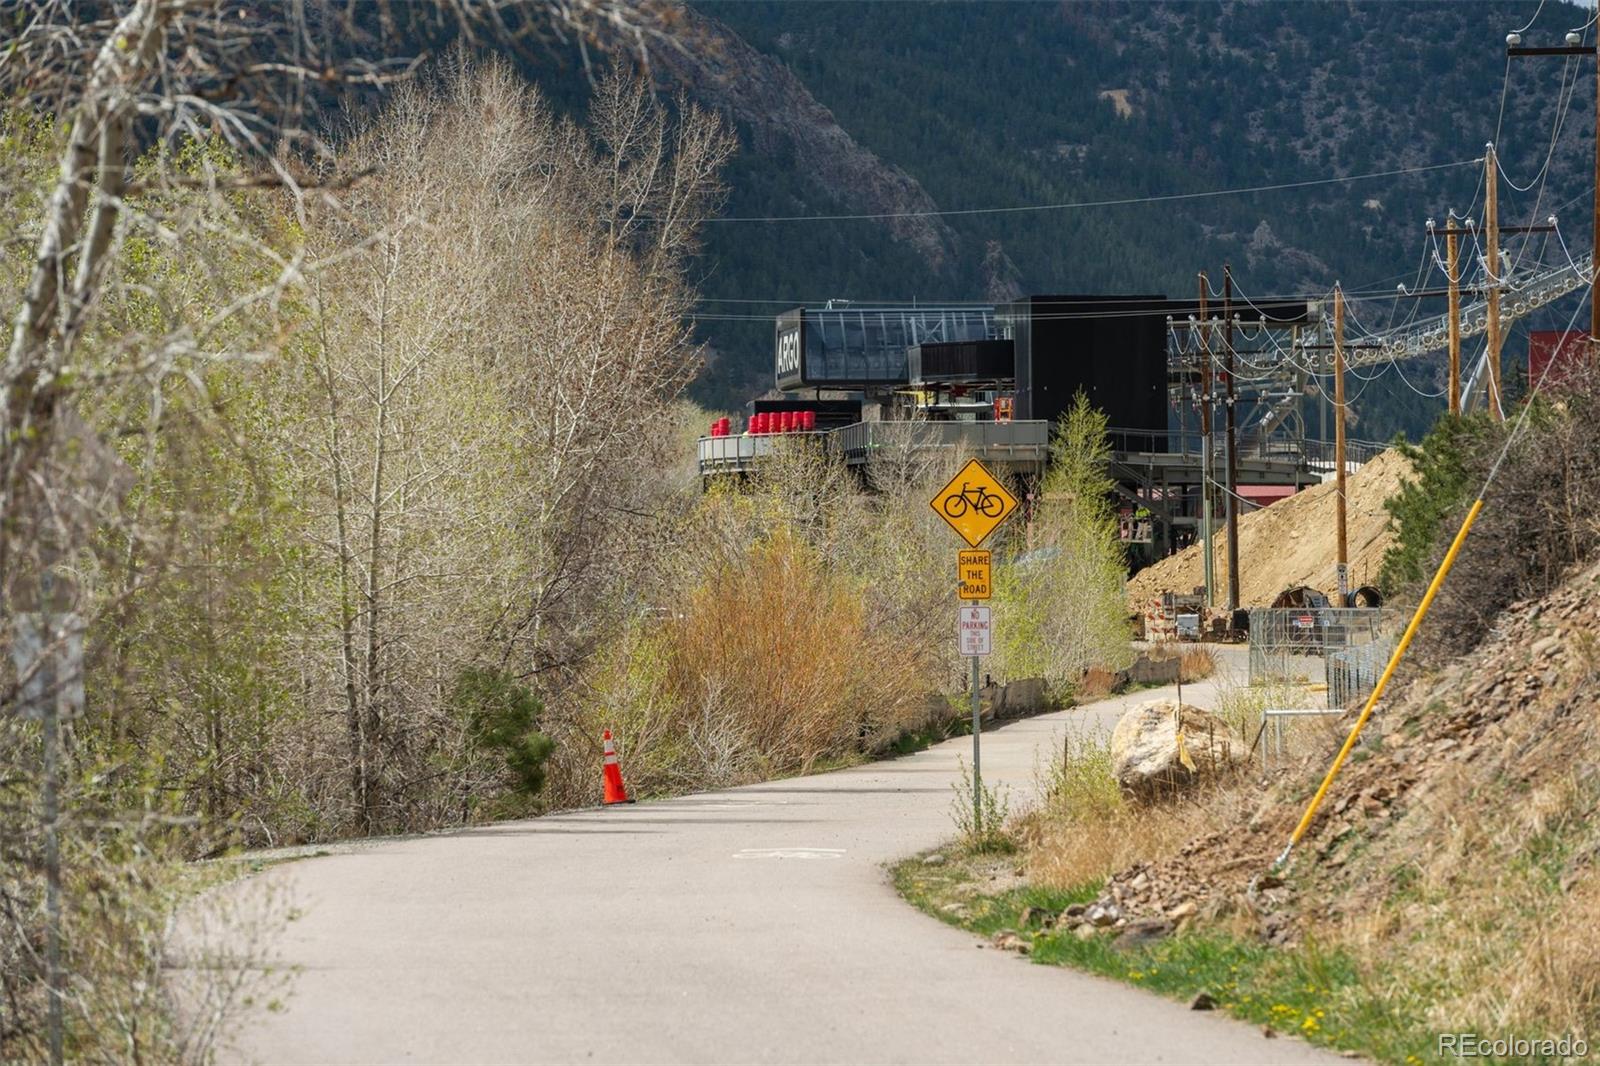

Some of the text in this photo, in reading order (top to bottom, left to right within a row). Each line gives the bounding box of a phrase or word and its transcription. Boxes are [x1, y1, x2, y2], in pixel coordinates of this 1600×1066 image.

[778, 331, 799, 374] ARGO
[960, 556, 989, 565] SHARE
[967, 570, 983, 580] THE
[964, 584, 986, 594] ROAD
[971, 611, 980, 620] NO
[962, 621, 988, 630] PARKING
